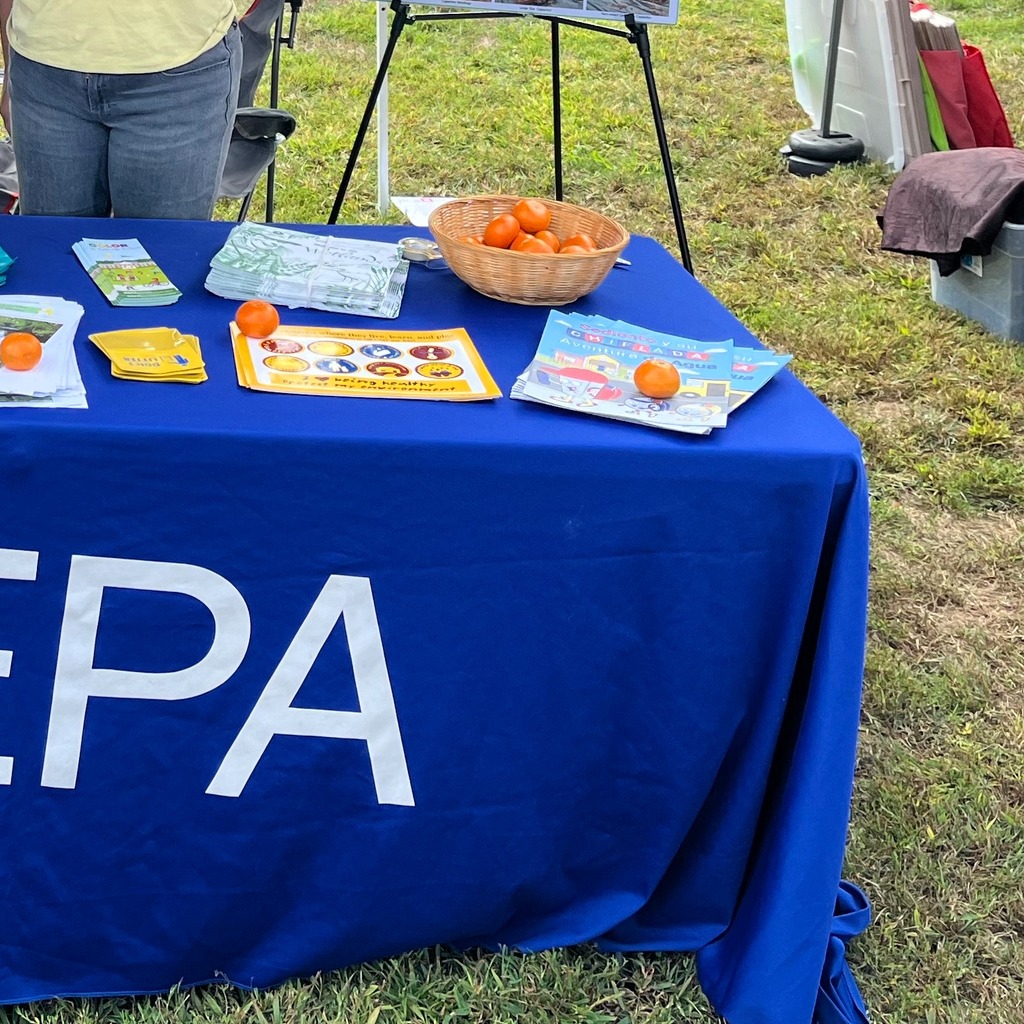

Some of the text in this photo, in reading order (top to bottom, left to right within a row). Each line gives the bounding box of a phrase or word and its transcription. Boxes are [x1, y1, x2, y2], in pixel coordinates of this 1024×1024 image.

[560, 338, 638, 359] Aventura
[672, 360, 717, 370] Agua
[570, 330, 704, 360] CHIFLADA
